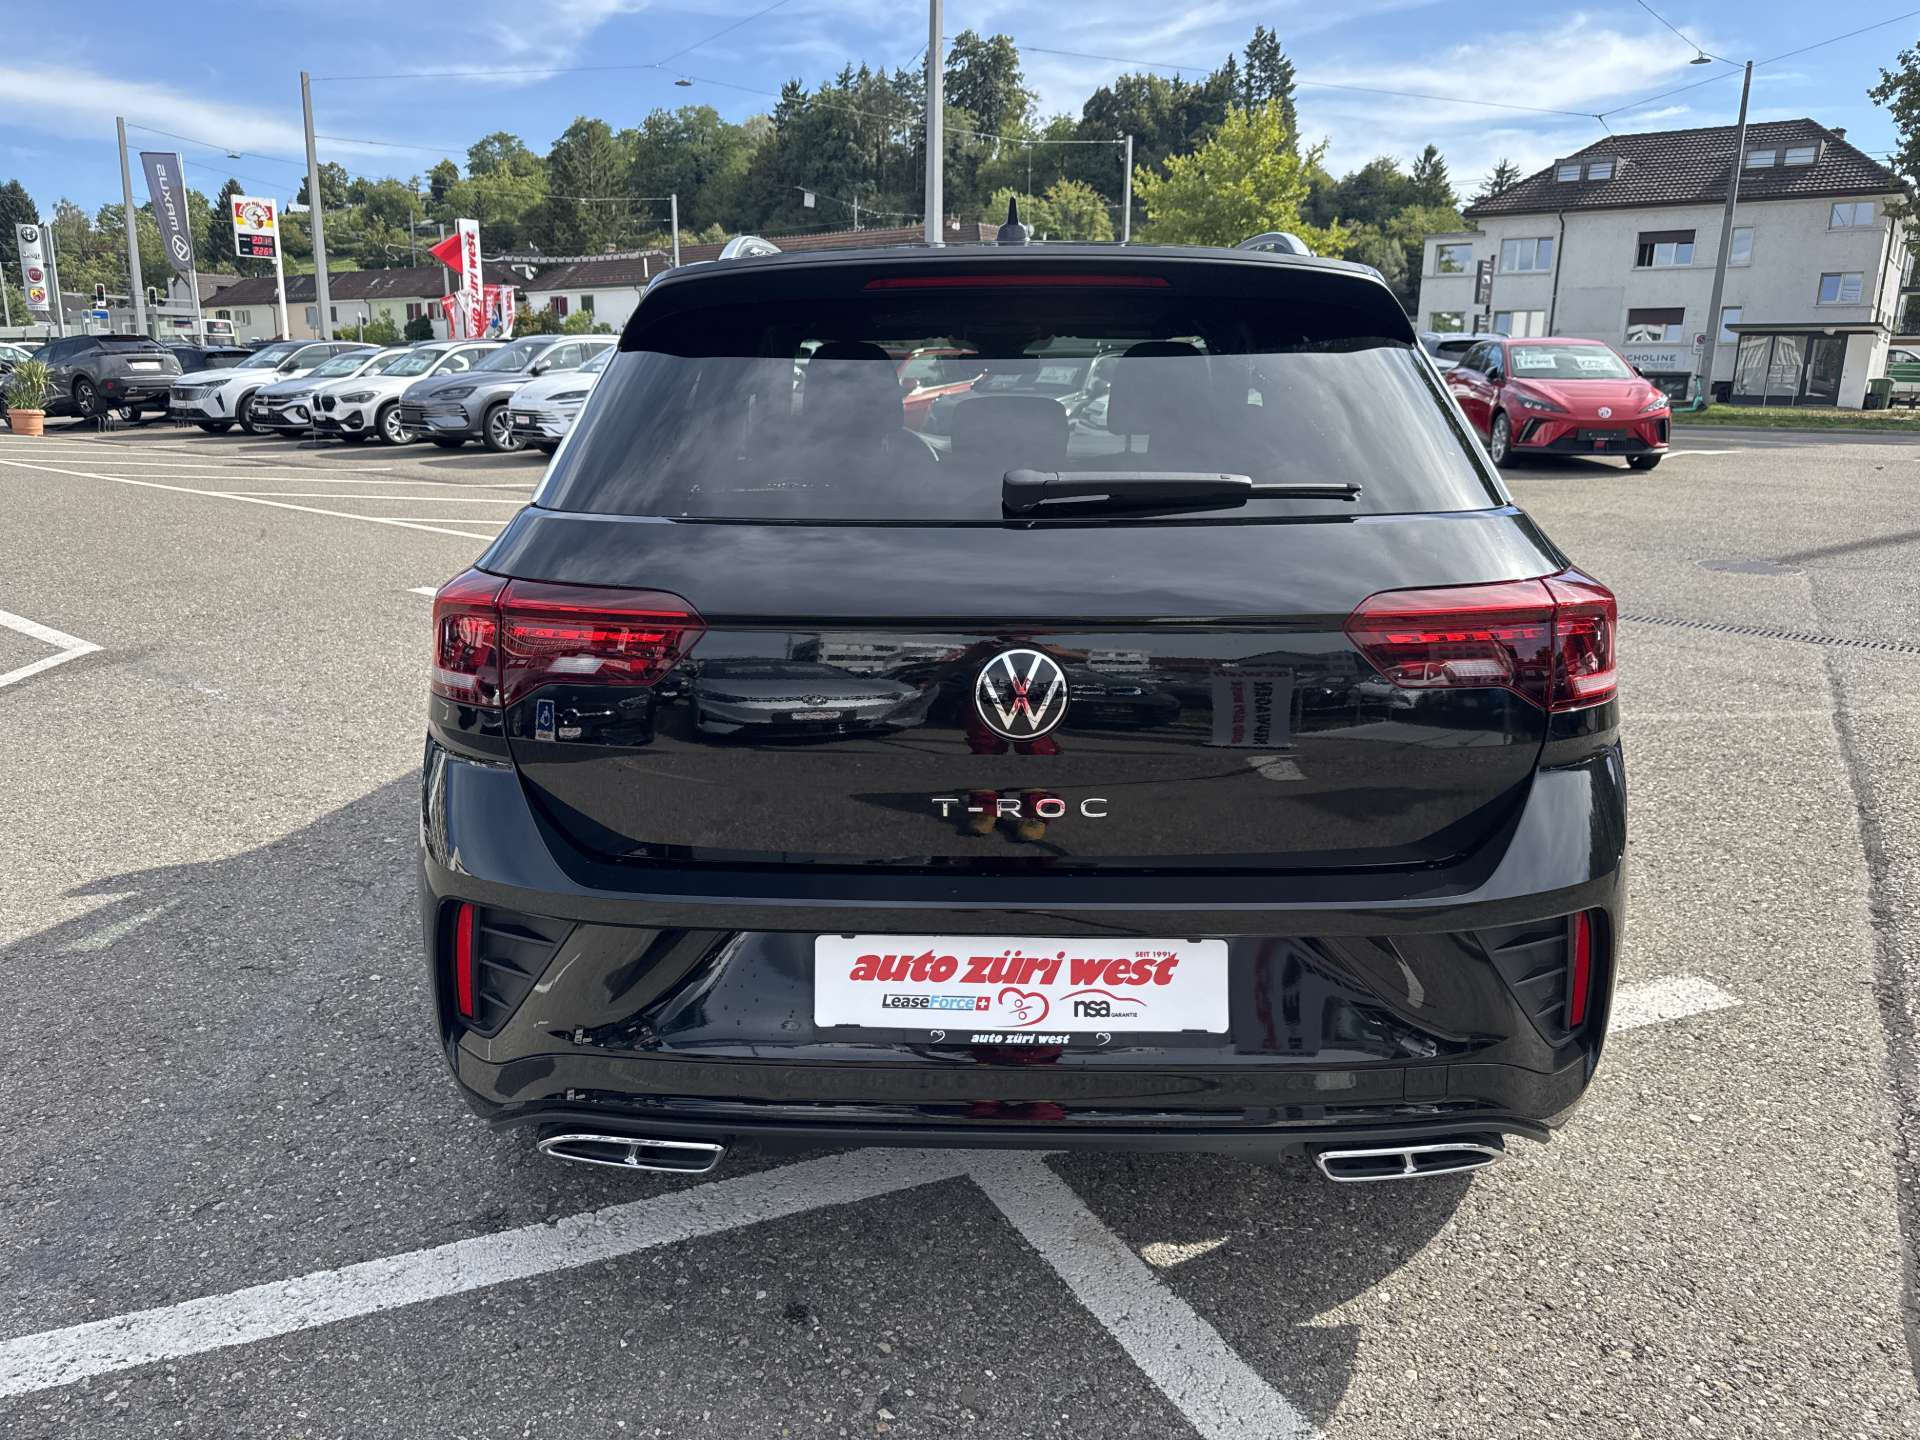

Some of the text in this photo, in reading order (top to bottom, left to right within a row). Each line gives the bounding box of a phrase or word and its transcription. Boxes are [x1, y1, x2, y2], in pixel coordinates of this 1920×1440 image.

[466, 231, 477, 269] west
[931, 798, 1108, 818] T-ROC
[849, 949, 1180, 986] auto züri west
[882, 993, 976, 1010] LeaseForce
[1073, 1000, 1111, 1018] nsa
[971, 1033, 1070, 1044] auto züri west
